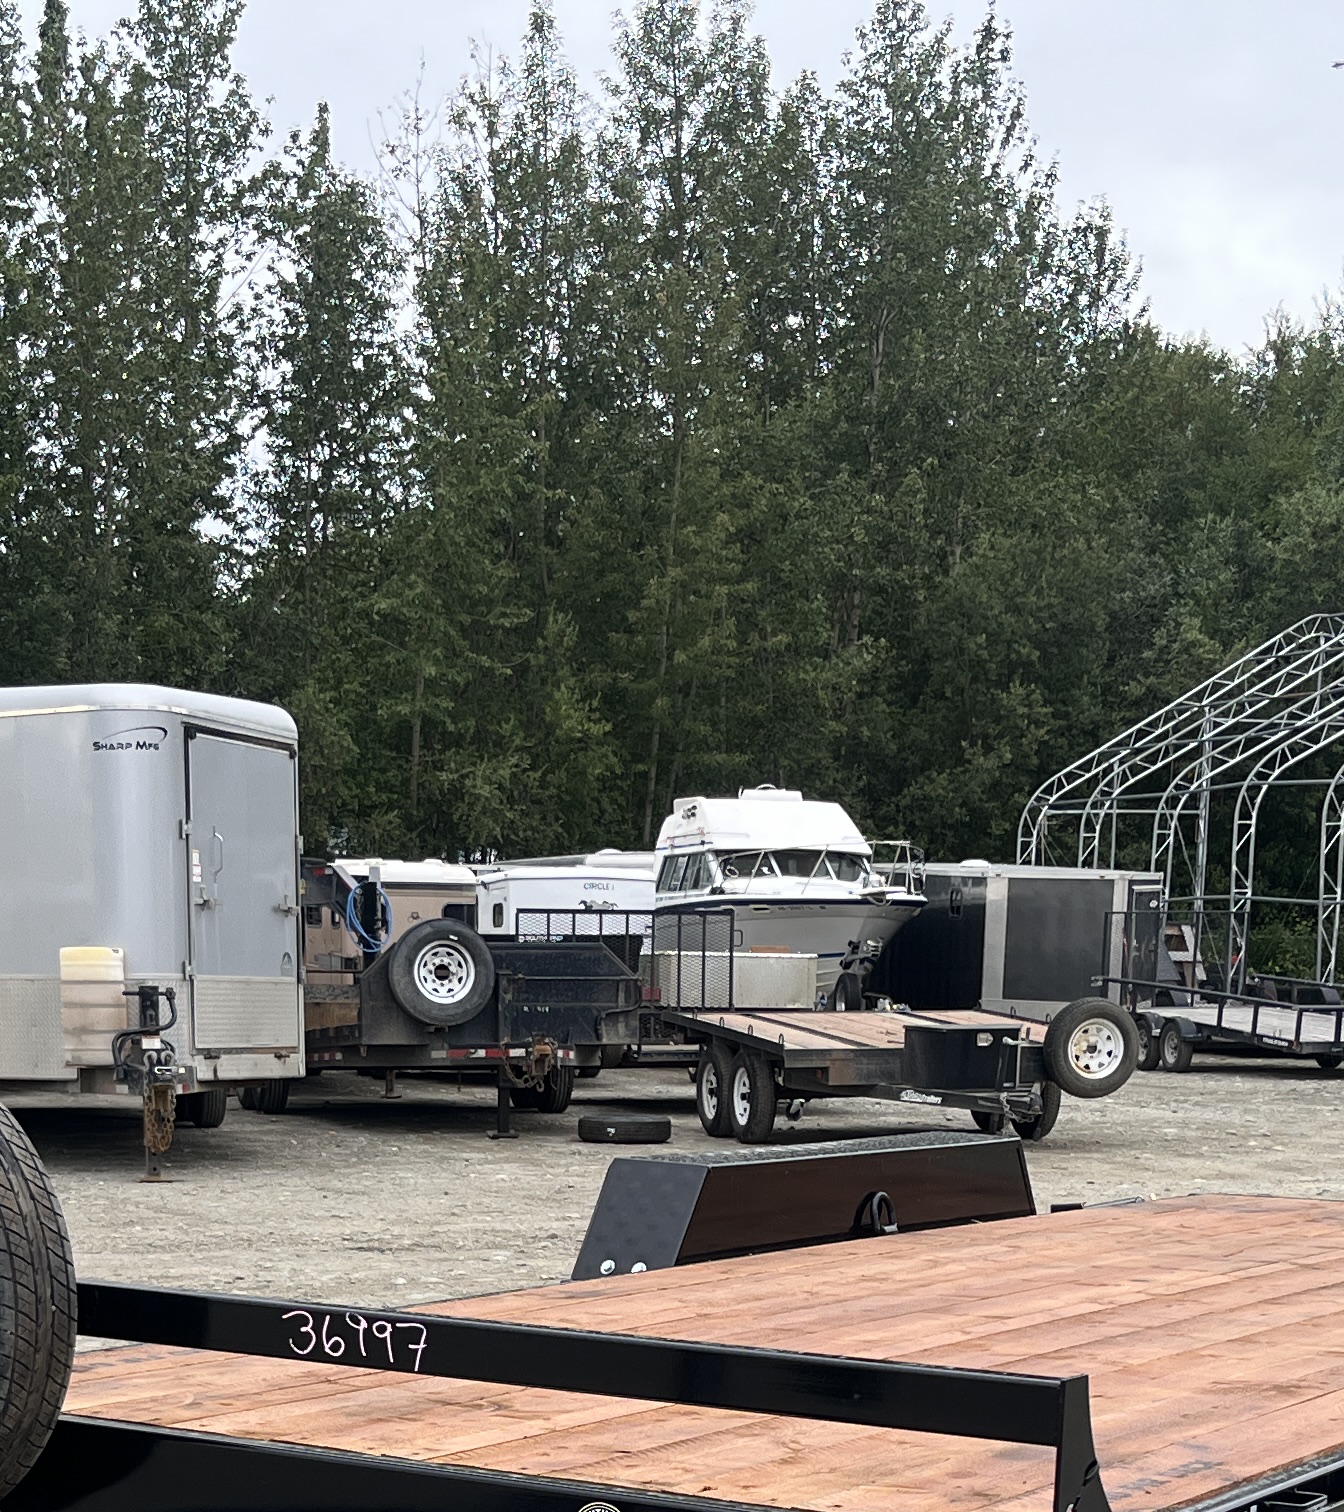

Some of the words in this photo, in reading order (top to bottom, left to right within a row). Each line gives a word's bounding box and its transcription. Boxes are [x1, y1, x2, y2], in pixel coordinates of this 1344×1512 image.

[92, 741, 133, 752] SHARP
[583, 882, 610, 891] CIRCLE
[281, 1310, 428, 1372] 36997
